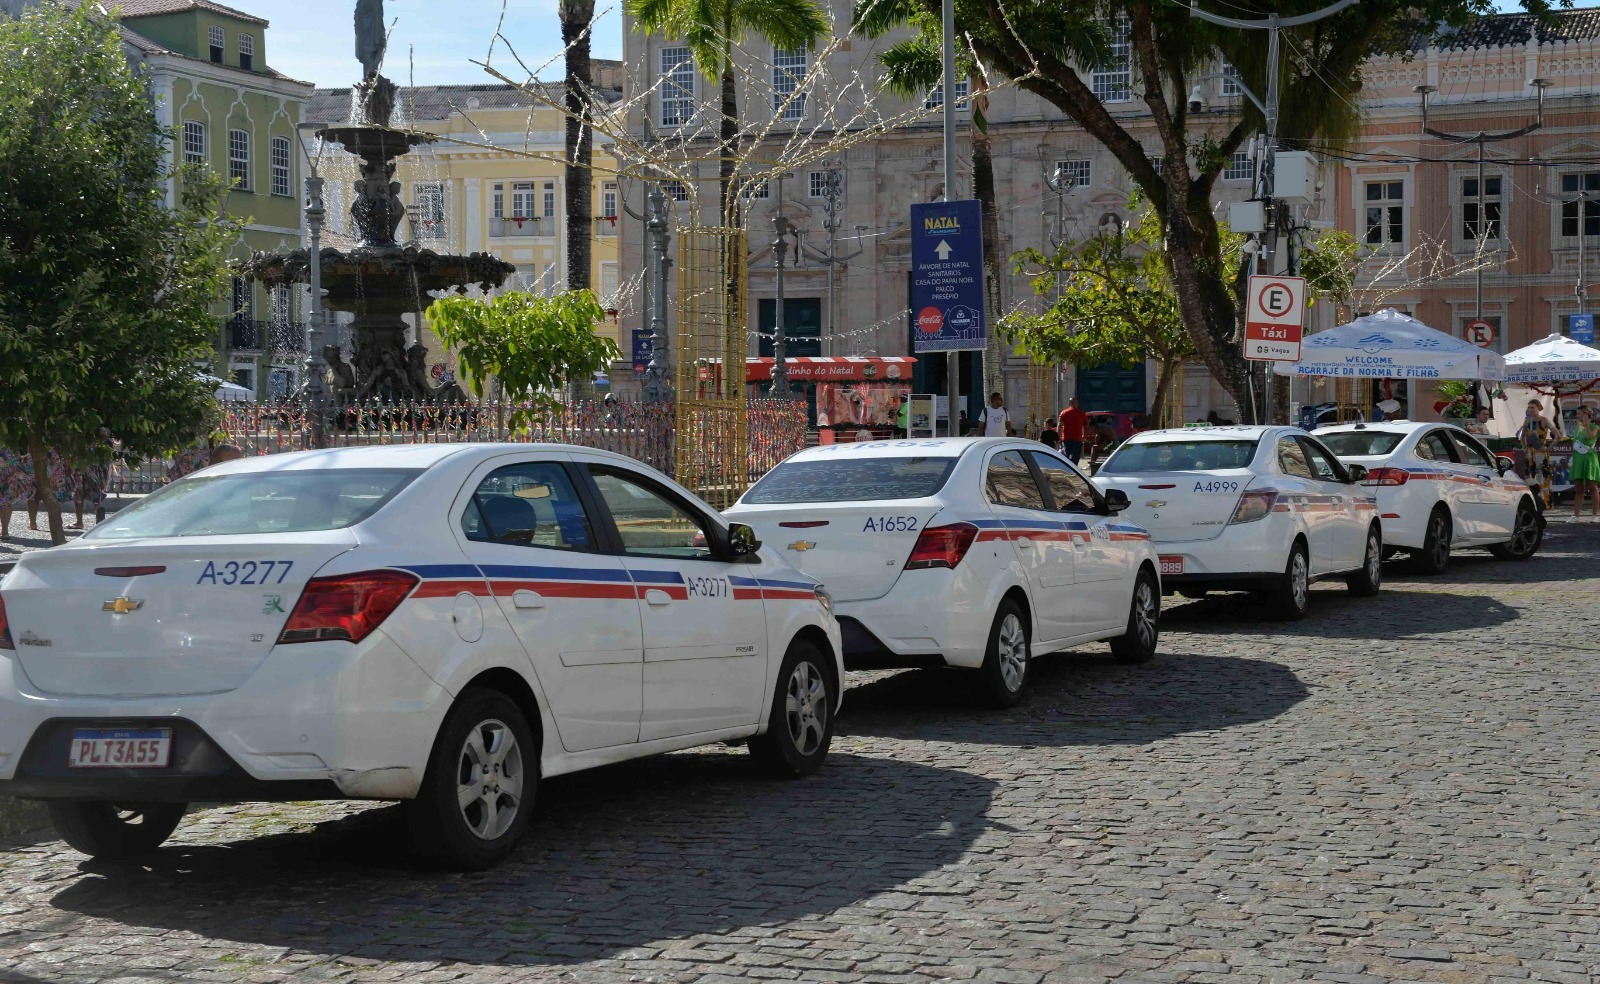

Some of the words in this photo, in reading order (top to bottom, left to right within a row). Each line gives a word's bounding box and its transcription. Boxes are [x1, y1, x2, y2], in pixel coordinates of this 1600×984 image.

[925, 216, 961, 229] NATAL
[918, 262, 942, 271] ÁRVORE
[951, 261, 970, 269] NATAL
[928, 269, 962, 278] SANITÁRIOS
[915, 278, 932, 286] CASA
[958, 276, 974, 284] NOEL
[935, 285, 955, 293] PALCO
[931, 291, 959, 300] PRESÉPIO
[1269, 290, 1283, 310] E
[918, 315, 942, 325] Coca-Cola
[1261, 326, 1287, 339] Táxi
[1271, 347, 1290, 355] Vagas
[1345, 356, 1393, 364] WELCOME
[814, 366, 826, 375] do
[829, 366, 854, 375] Natal
[1342, 367, 1354, 376] DA
[1358, 368, 1392, 376] NORMA
[1406, 369, 1439, 377] FILHAS
[1193, 481, 1239, 493] A-4999
[863, 516, 918, 533] A-1652
[196, 560, 294, 586] A-3277
[687, 577, 727, 598] A-3277
[79, 740, 160, 763] PLT3A55
